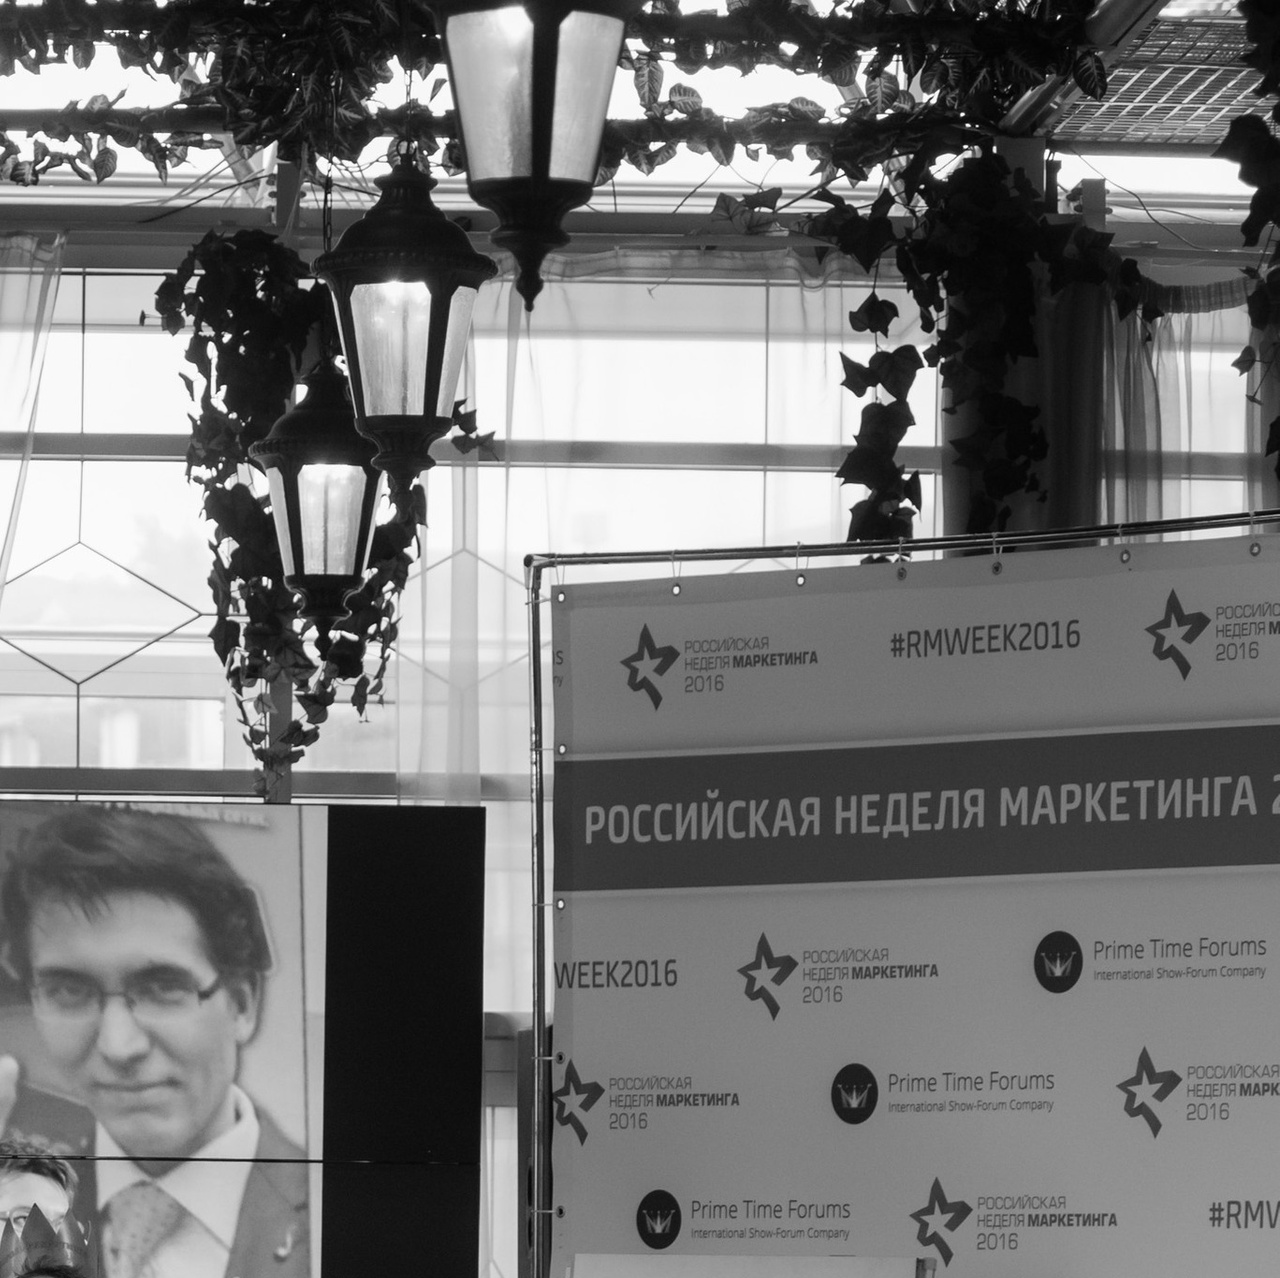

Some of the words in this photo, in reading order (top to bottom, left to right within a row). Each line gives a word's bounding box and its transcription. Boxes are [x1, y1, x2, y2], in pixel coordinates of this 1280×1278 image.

[890, 619, 1081, 659] #RMWEEK2016
[1216, 622, 1265, 639] НЕДЕЛЯ
[684, 637, 769, 655] РОССИЙСКАЯ
[1216, 642, 1259, 661] 2016
[684, 656, 730, 673] НЕДЕЛЯ
[732, 651, 818, 669] МАРКЕТИНГА
[684, 675, 724, 693] 2016
[586, 789, 820, 845] РОССИЙСКАЯ
[836, 788, 985, 839] НЕДЕЛЯ
[1000, 775, 1257, 827] МАРКЕТИНГА
[803, 947, 889, 963] РОССИЙСКАЯ
[1094, 940, 1144, 960] Prime
[1149, 938, 1193, 959] Time
[1199, 937, 1267, 958] Forums
[803, 967, 849, 983] НЕДЕЛЯ
[852, 964, 939, 979] МАРКЕТИНГА
[1094, 968, 1154, 981] International
[1156, 966, 1218, 979] Show-Forum
[1220, 965, 1267, 980] Company
[803, 986, 842, 1003] 2016
[1187, 1064, 1280, 1080] РОССИЙСКАЯ
[609, 1075, 692, 1090] РОССИЙСКАЯ
[889, 1073, 937, 1092] Prime
[942, 1071, 984, 1091] Time
[990, 1071, 1055, 1090] Forums
[1187, 1083, 1236, 1100] НЕДЕЛЯ
[609, 1094, 653, 1109] НЕДЕЛЯ
[656, 1093, 740, 1107] МАРКЕТИНГА
[889, 1100, 947, 1113] International
[949, 1099, 1008, 1112] Show-Forum
[1010, 1098, 1055, 1112] Company
[1187, 1102, 1230, 1121] 2016
[609, 1112, 648, 1129] 2016
[691, 1200, 738, 1219] Prime
[742, 1199, 783, 1219] Time
[788, 1199, 851, 1219] Forums
[977, 1195, 1066, 1211] РОССИЙСКАЯ
[977, 1213, 1025, 1230] НЕДЕЛЯ
[1028, 1213, 1118, 1227] МАРКЕТИНГА
[691, 1228, 746, 1239] International
[749, 1227, 805, 1239] Show-Forum
[807, 1227, 850, 1242] Company
[977, 1233, 1018, 1251] 2016
